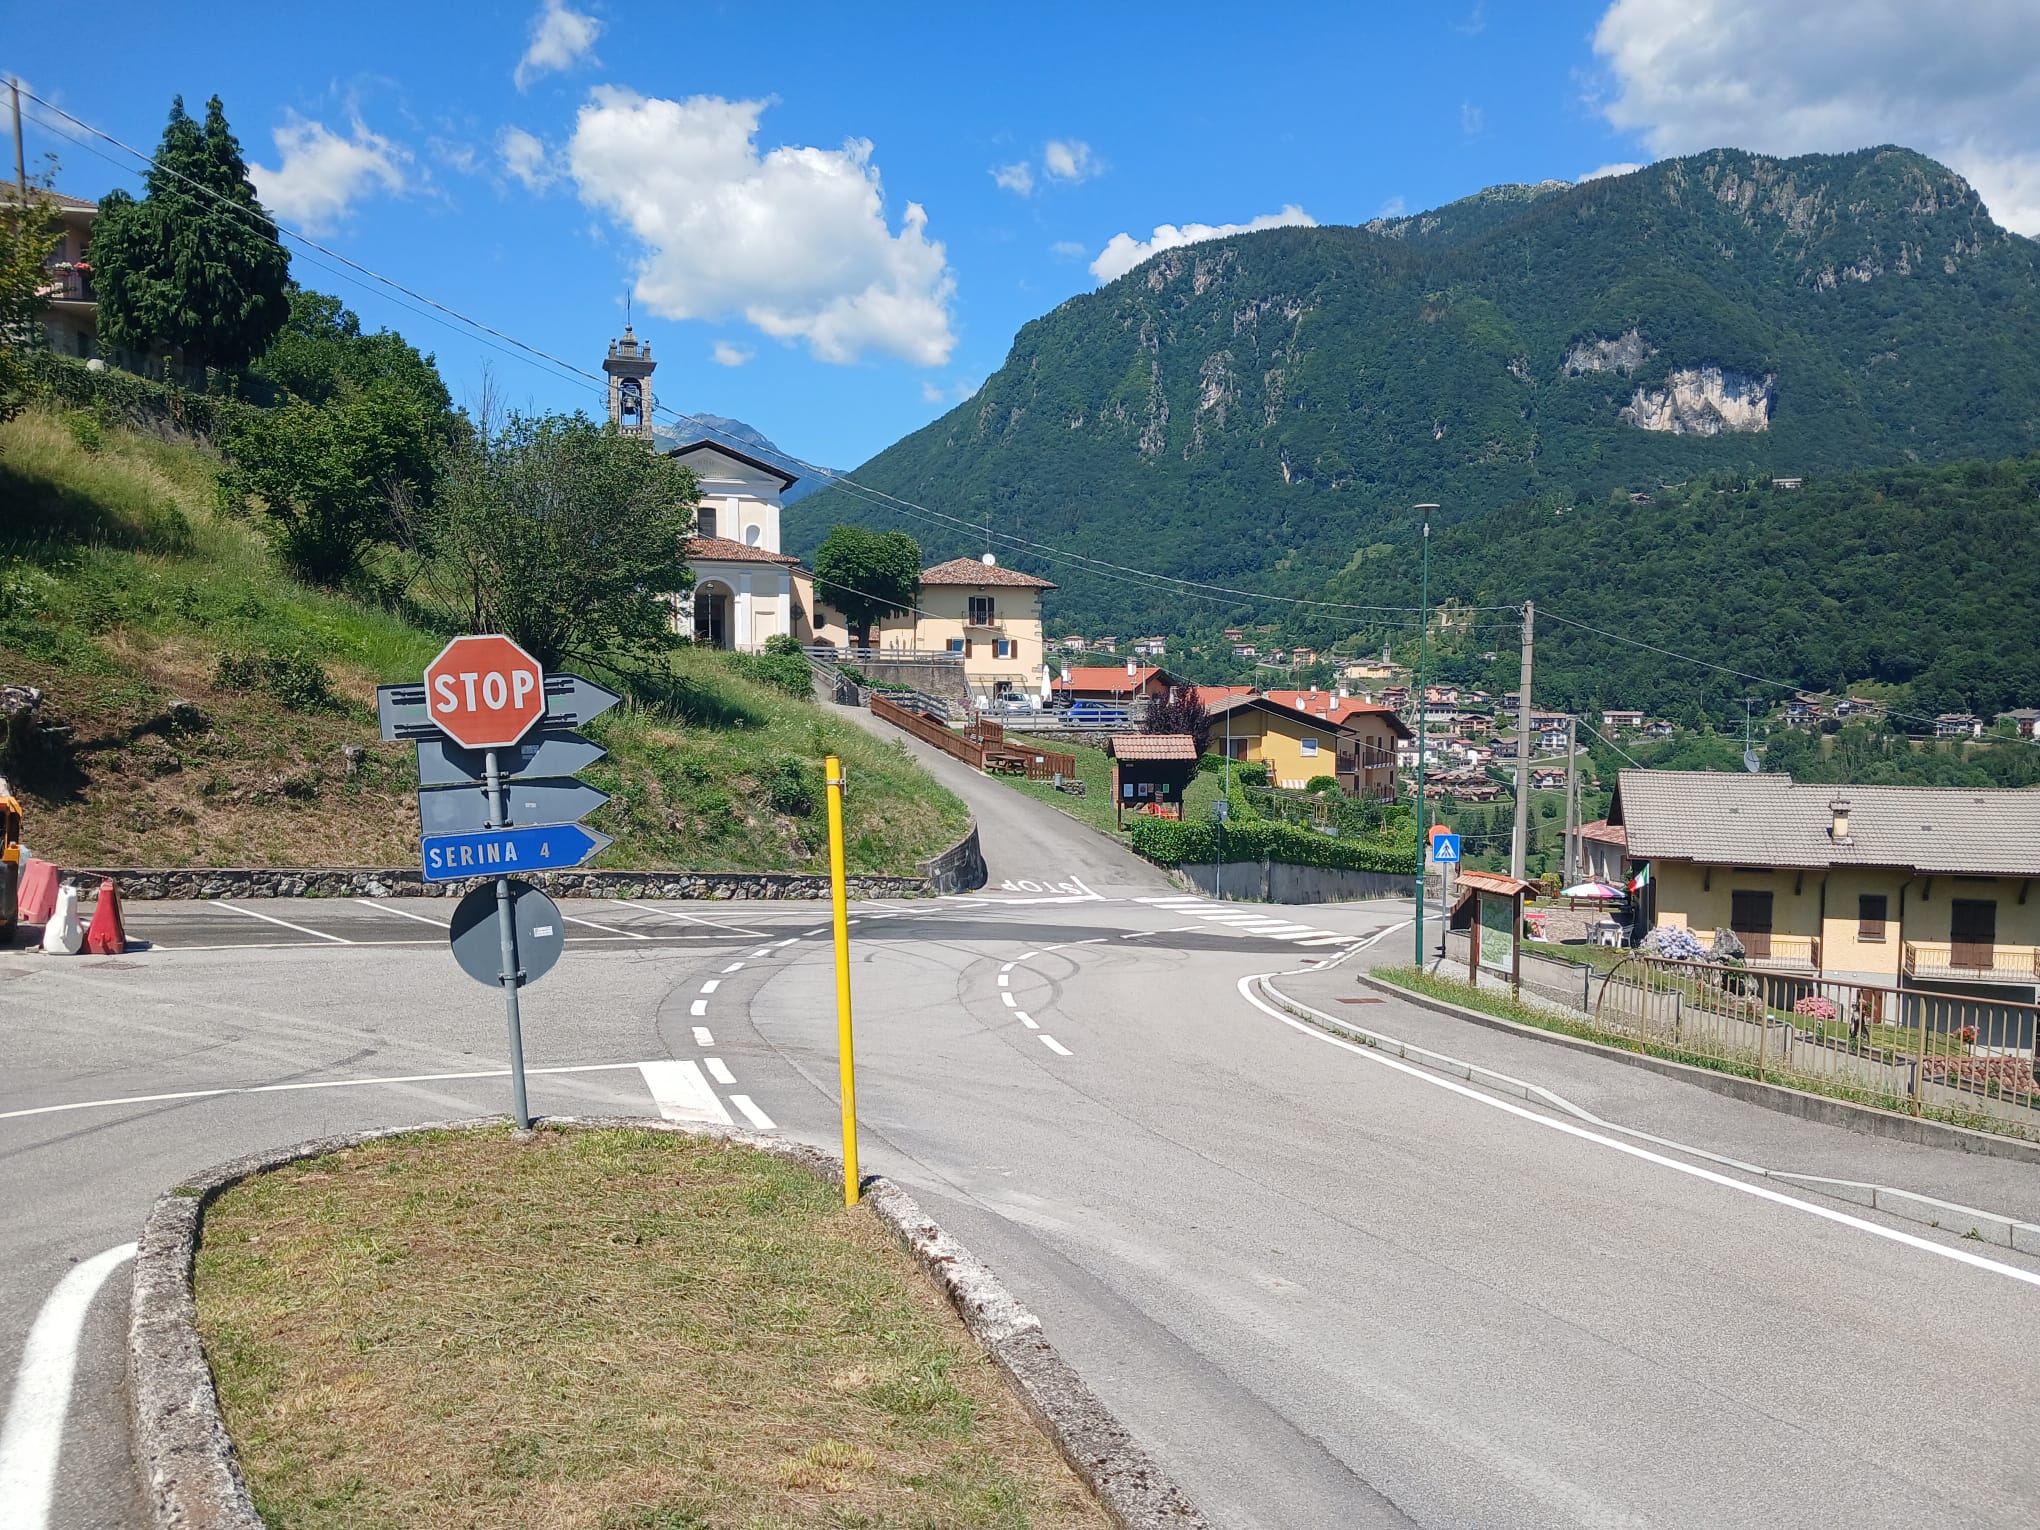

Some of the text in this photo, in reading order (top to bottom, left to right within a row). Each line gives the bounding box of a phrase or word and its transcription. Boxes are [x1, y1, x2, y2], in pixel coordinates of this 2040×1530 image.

[434, 670, 534, 713] STOP
[429, 841, 550, 868] SERINA 4
[1001, 879, 1081, 895] STOP
